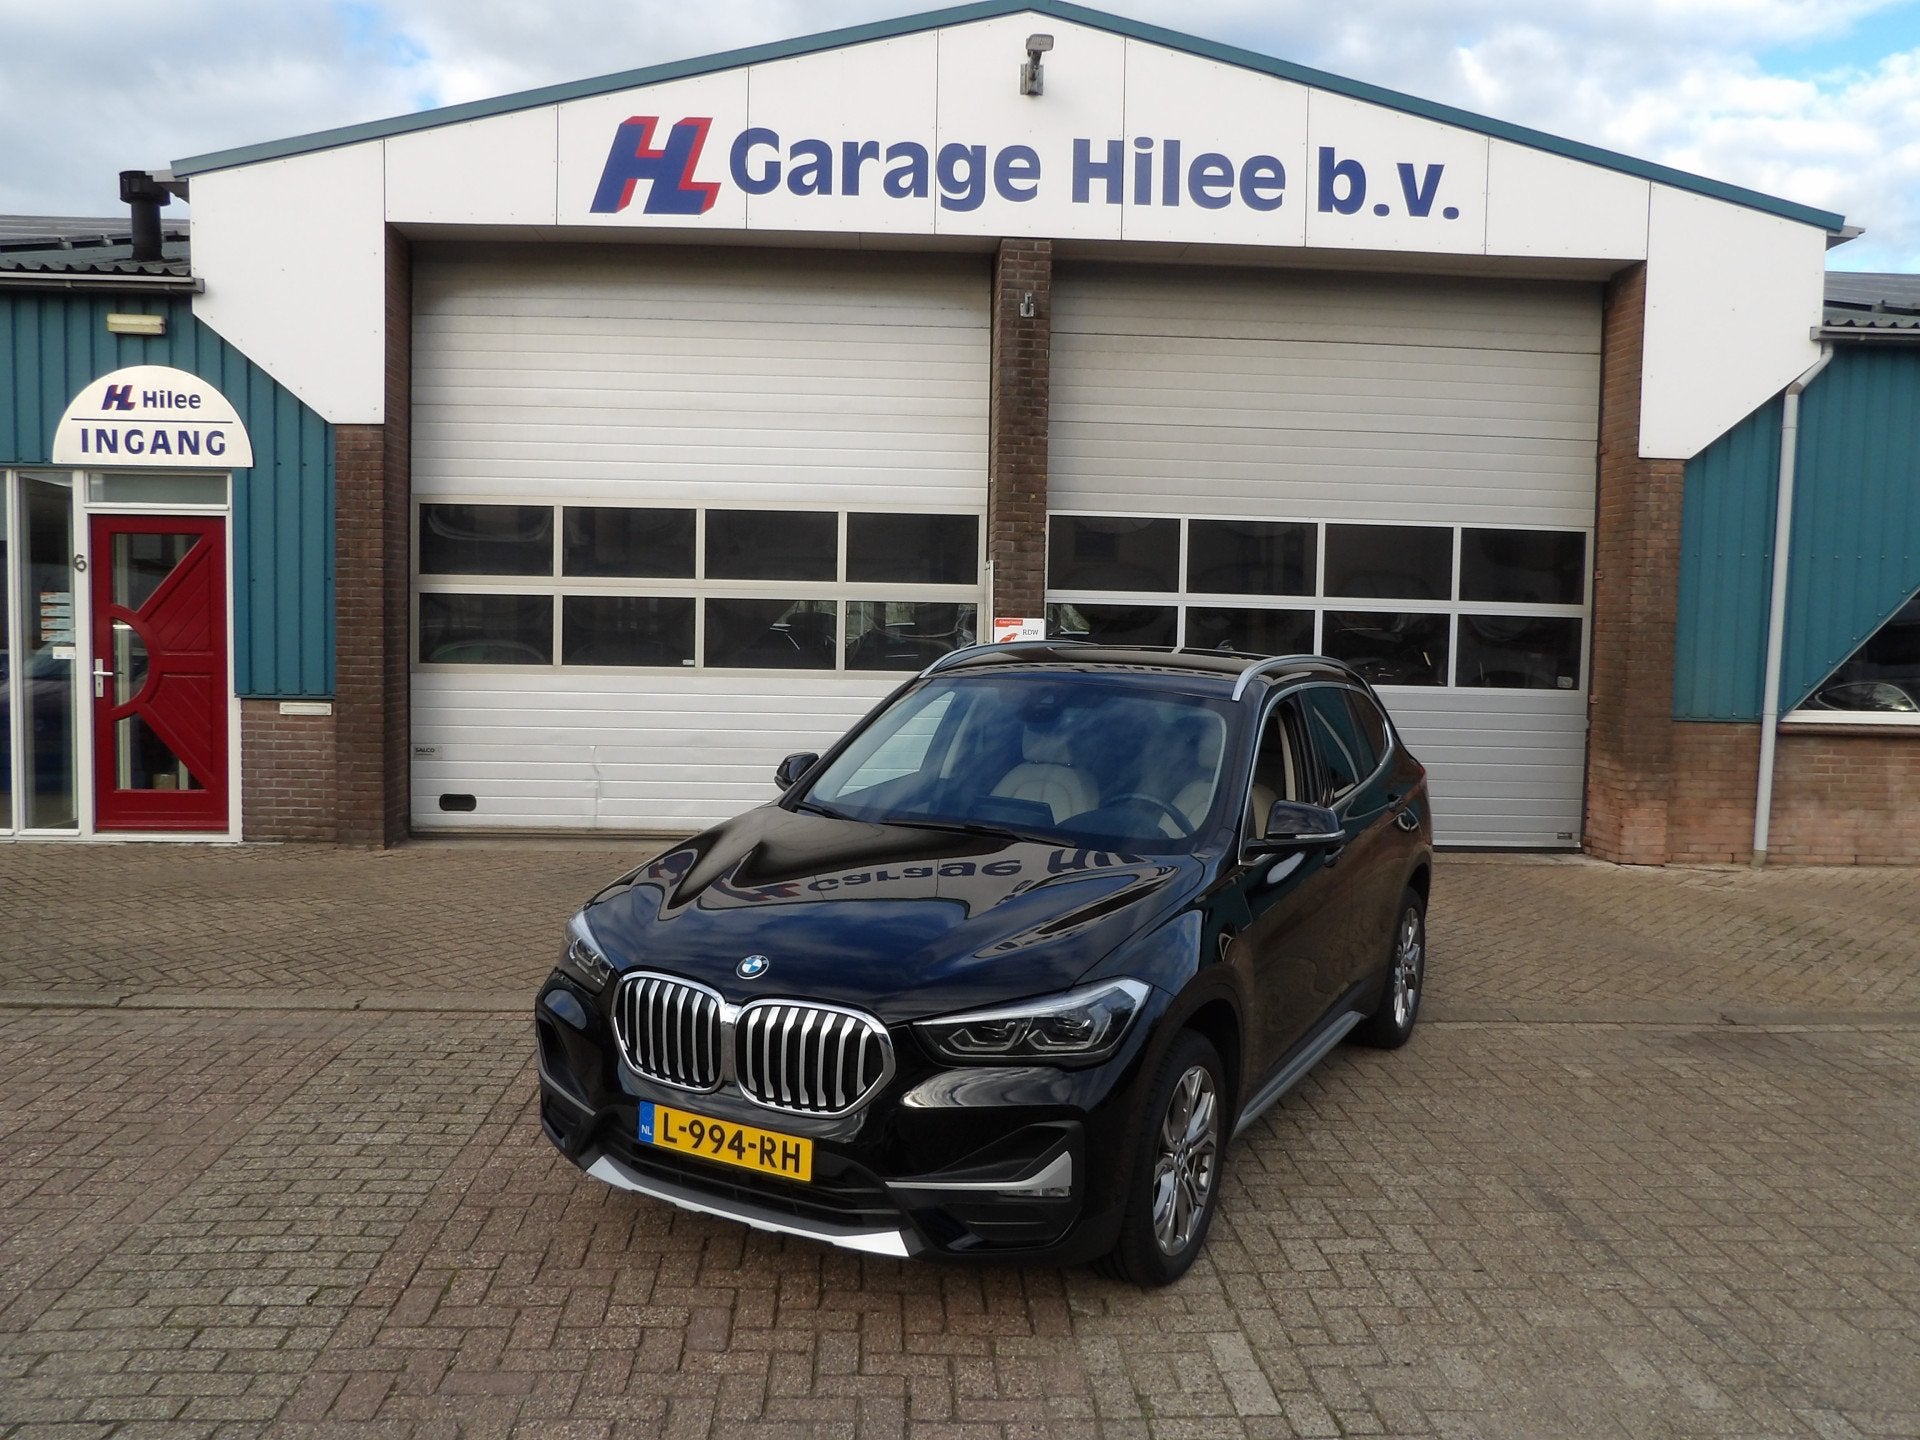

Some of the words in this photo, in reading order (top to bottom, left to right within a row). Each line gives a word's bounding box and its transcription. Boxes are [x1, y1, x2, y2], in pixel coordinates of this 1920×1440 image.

[729, 127, 1041, 212] Garage
[1071, 136, 1287, 212] Hilee
[1317, 146, 1460, 220] b.v.
[142, 390, 202, 409] Hilee
[81, 428, 226, 456] INGANG
[73, 553, 87, 572] 6
[641, 1124, 653, 1136] NL
[663, 1112, 801, 1174] L-994-RH
